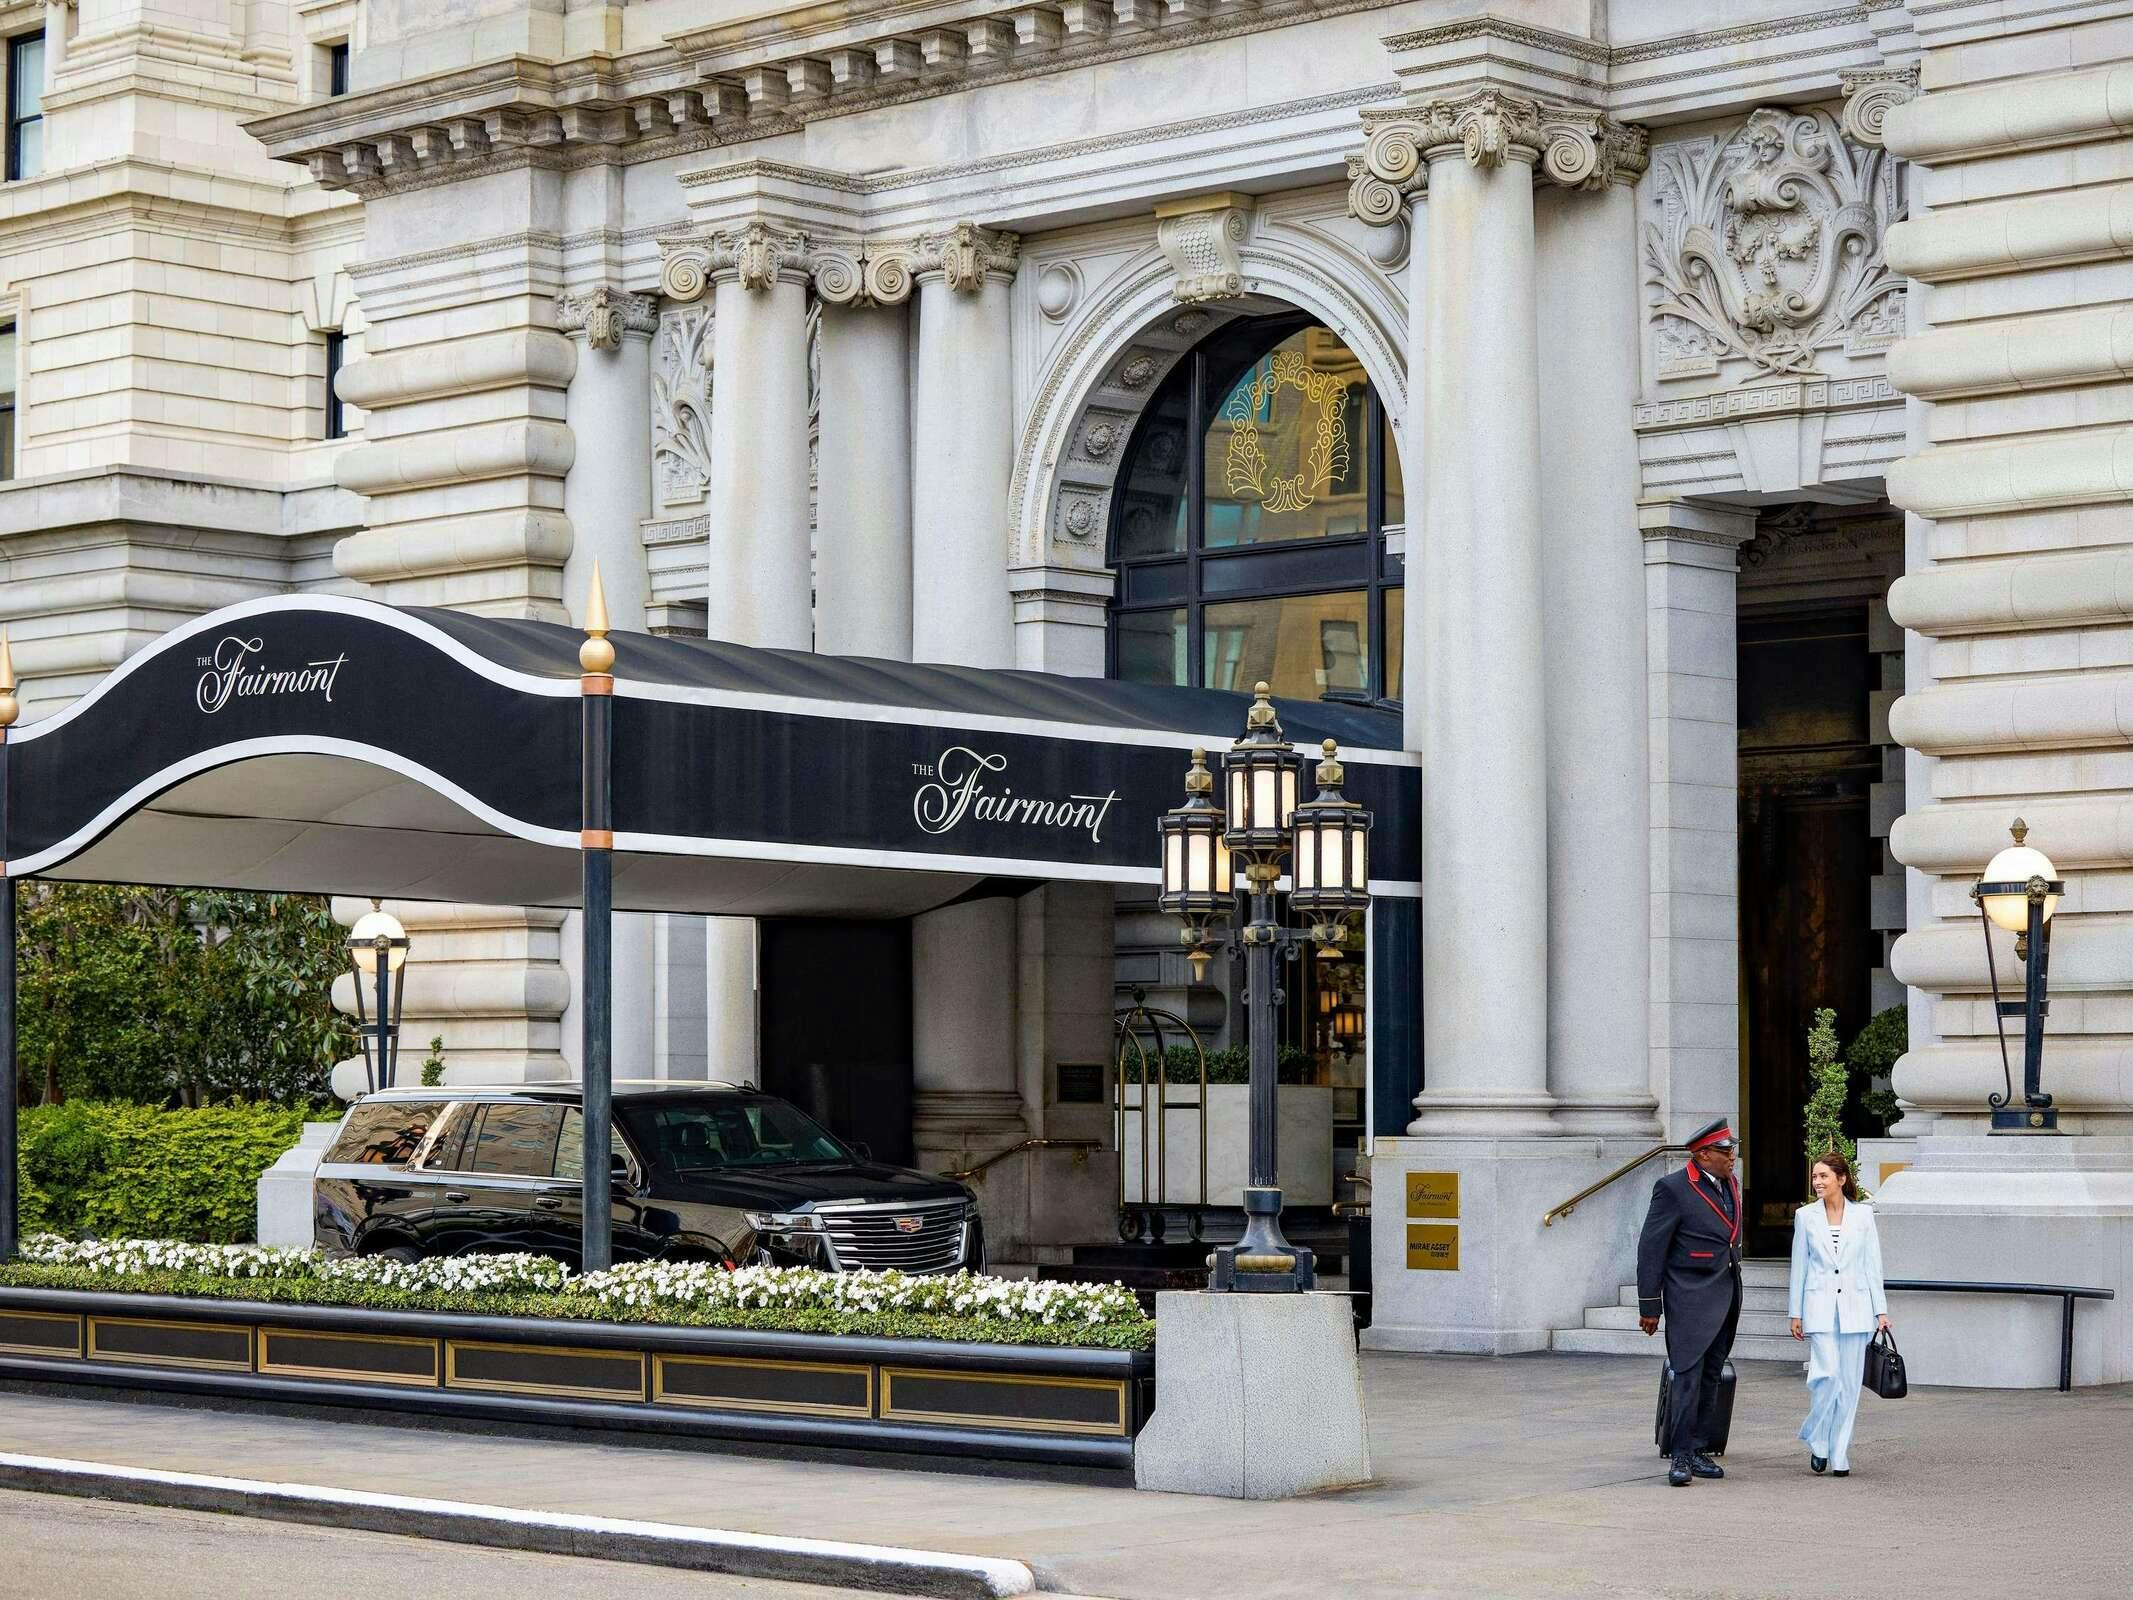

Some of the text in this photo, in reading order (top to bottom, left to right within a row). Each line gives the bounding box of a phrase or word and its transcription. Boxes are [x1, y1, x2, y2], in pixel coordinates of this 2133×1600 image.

[196, 636, 350, 714] THE Fairmont
[911, 746, 1123, 844] THE Fairmont
[1410, 1183, 1453, 1201] Fairmont
